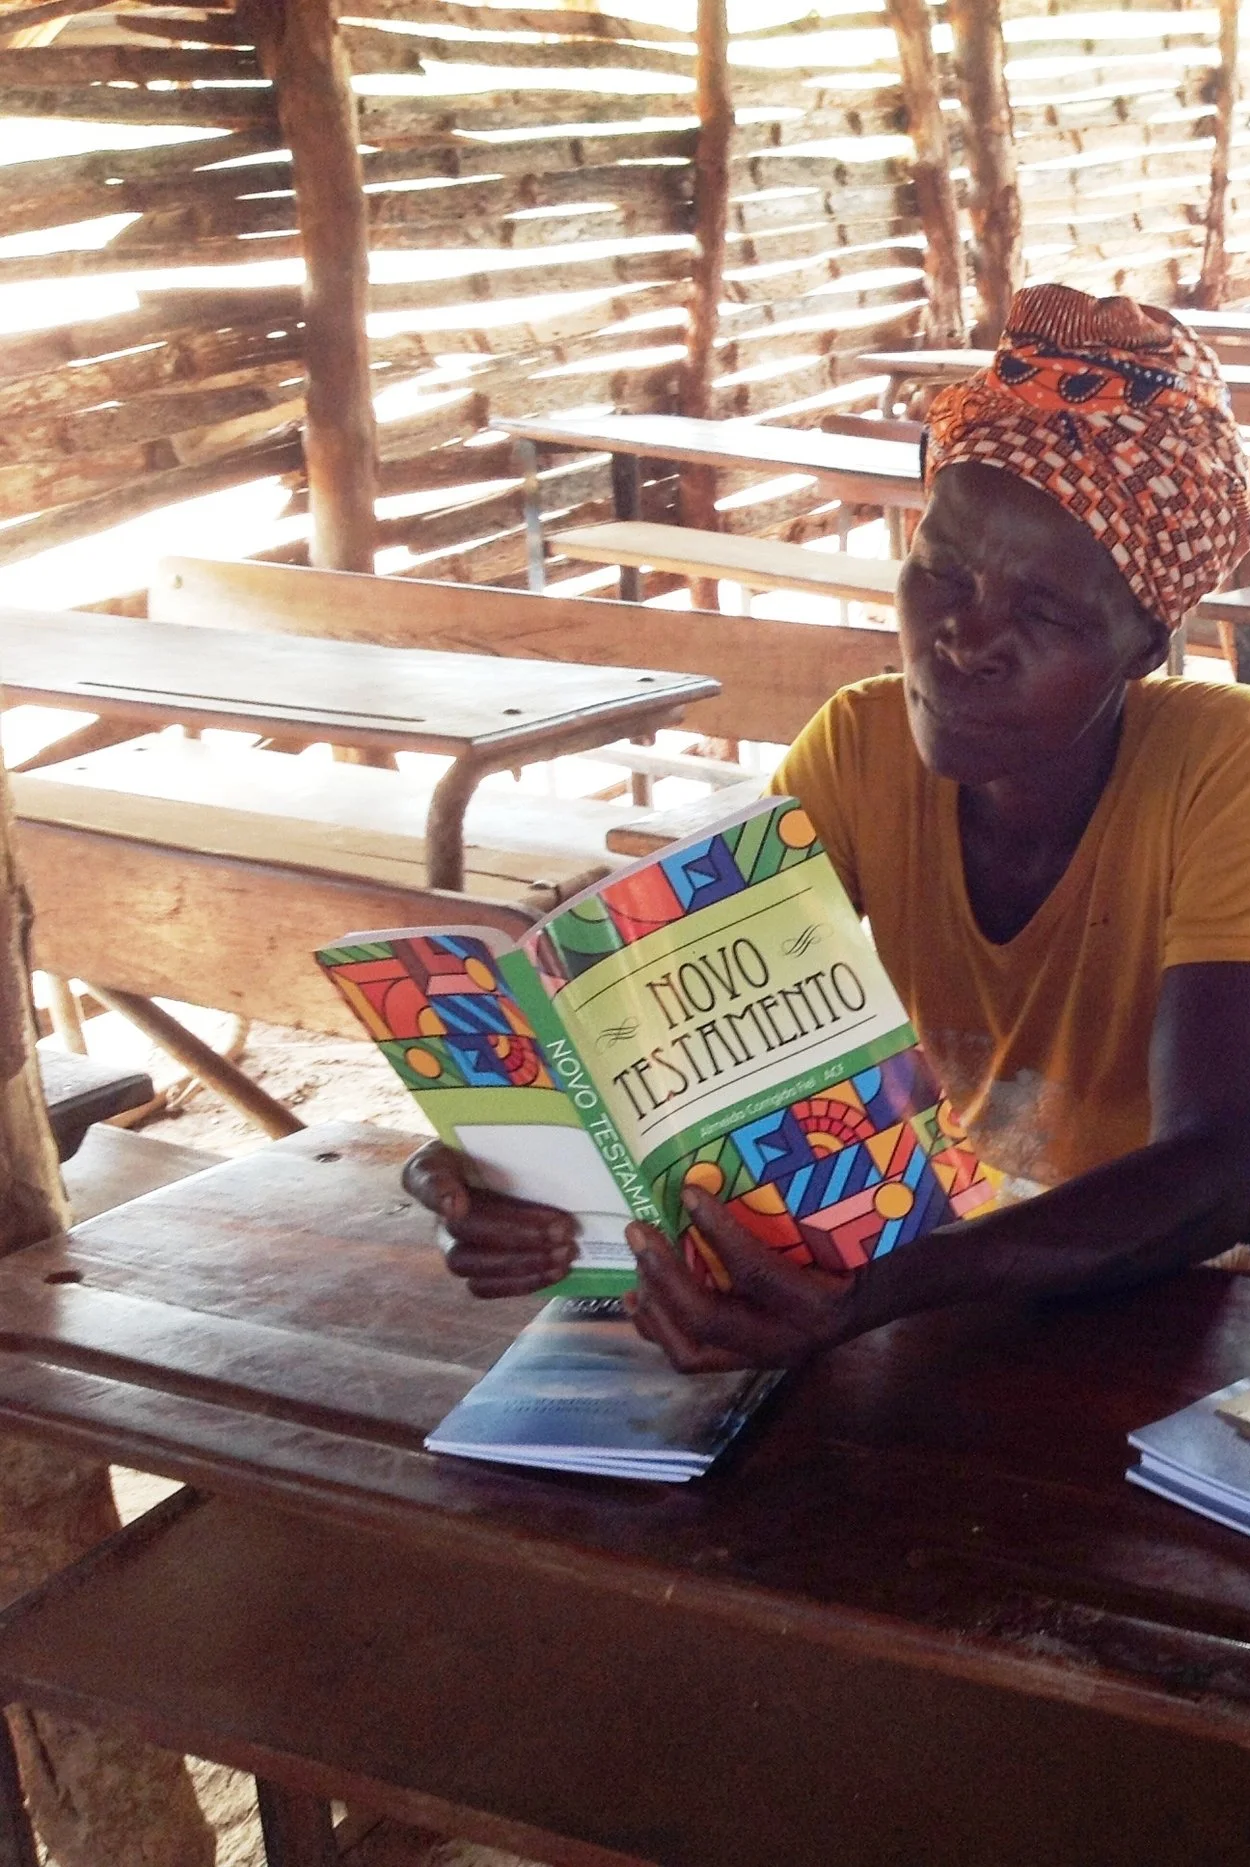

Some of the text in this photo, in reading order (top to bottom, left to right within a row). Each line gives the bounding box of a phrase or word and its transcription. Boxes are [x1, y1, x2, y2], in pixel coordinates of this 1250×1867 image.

[612, 962, 867, 1121] TESTAMENTO
[645, 937, 770, 1031] NOVO
[546, 1038, 599, 1110] NOVO
[588, 1111, 664, 1229] TESTAME
